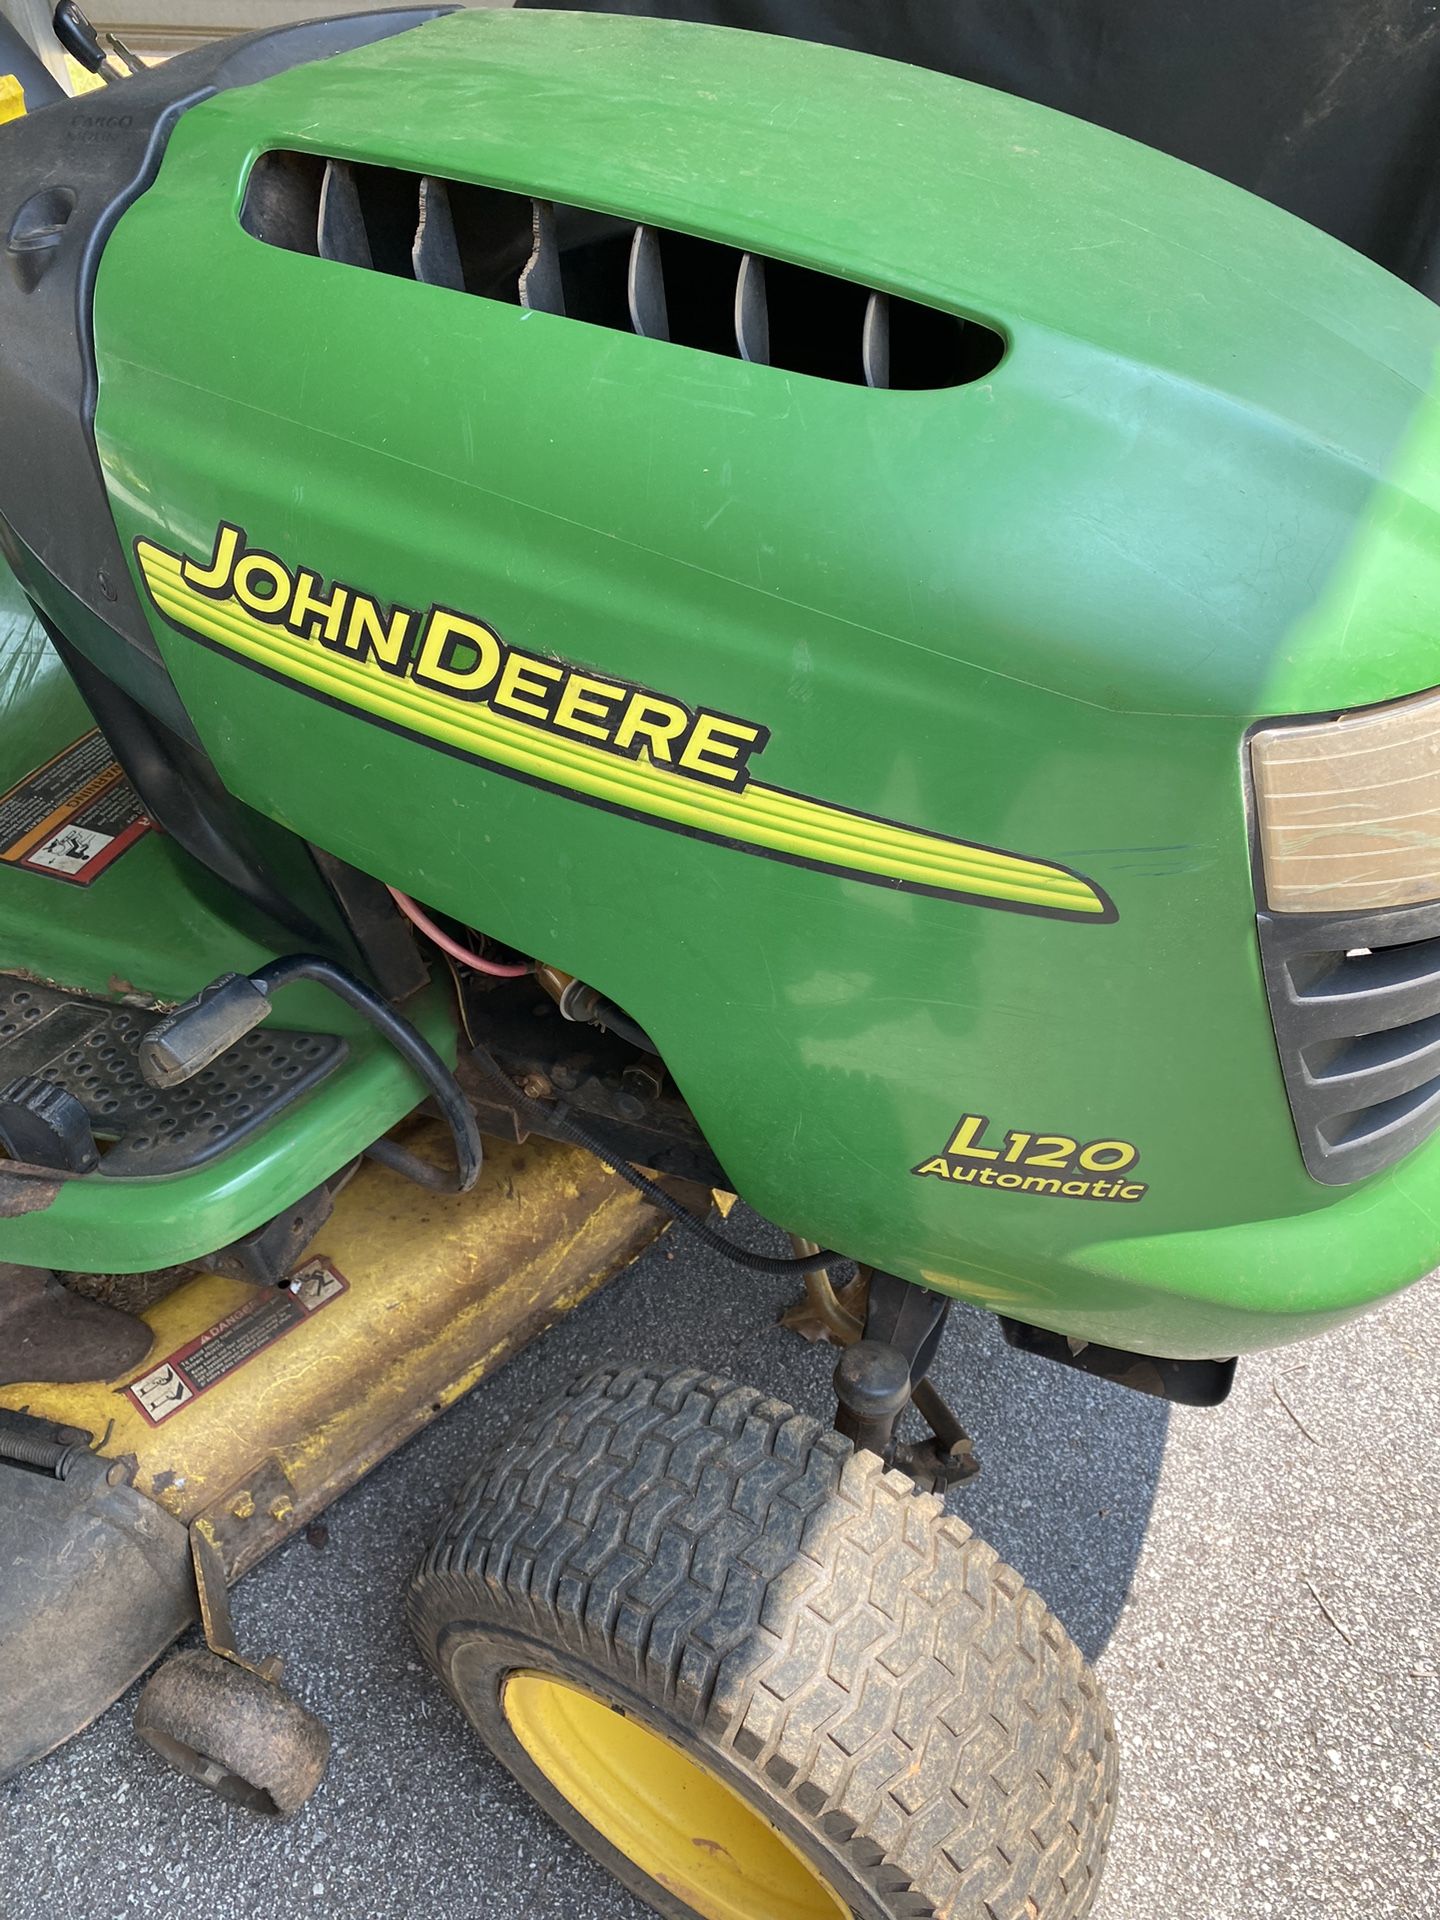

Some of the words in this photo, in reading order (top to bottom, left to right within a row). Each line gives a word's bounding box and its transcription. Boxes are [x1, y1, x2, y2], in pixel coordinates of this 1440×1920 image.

[183, 526, 412, 667] JOHN
[416, 606, 760, 783] DEERE
[948, 1116, 1136, 1172] L120
[917, 1158, 1145, 1199] Automatic
